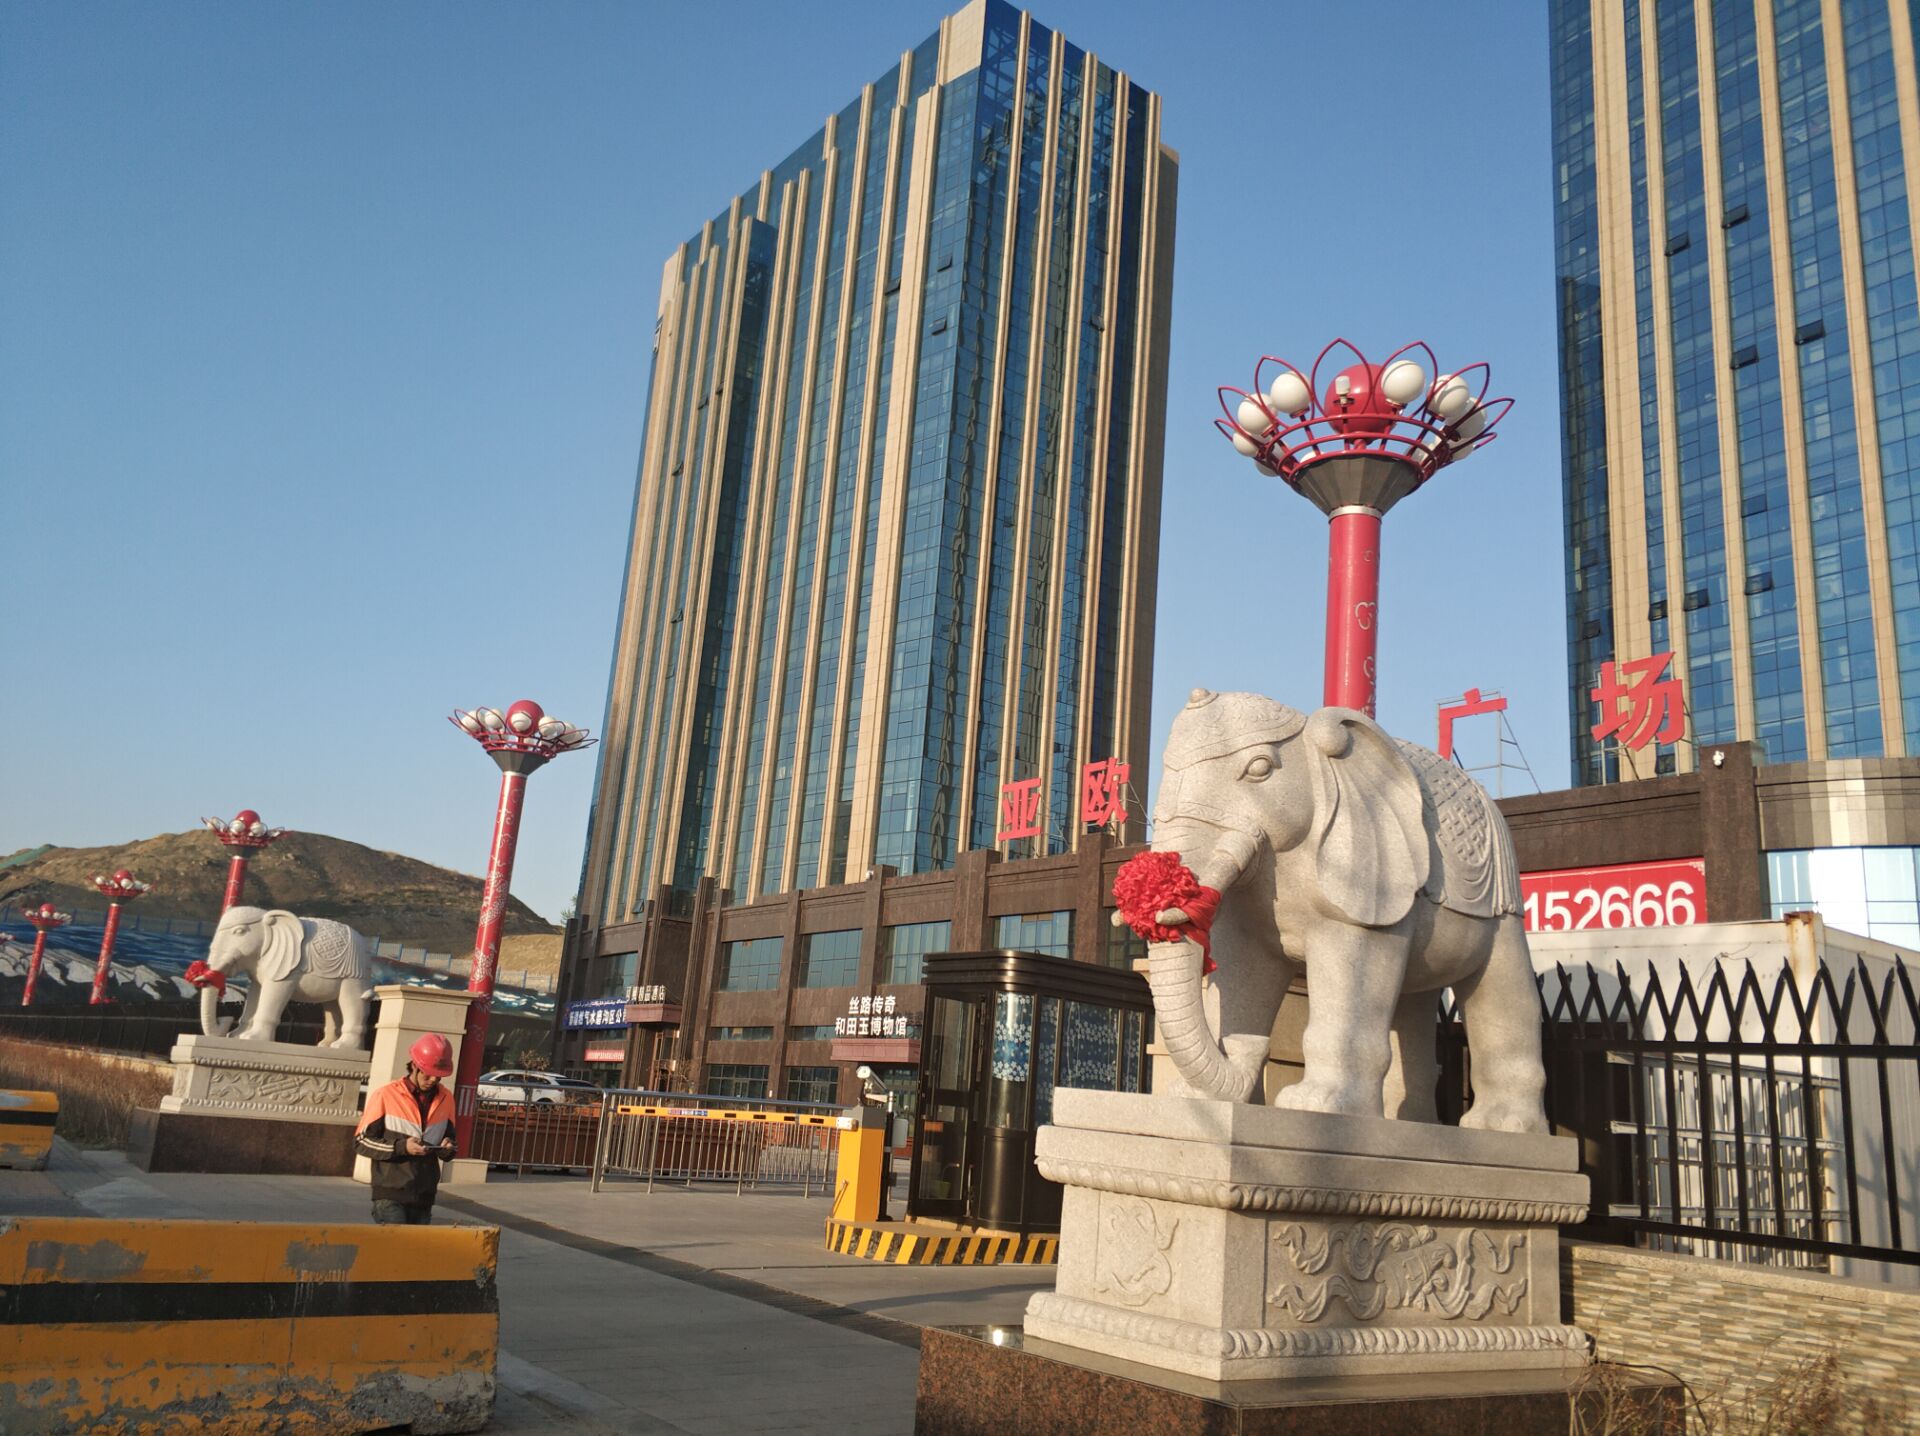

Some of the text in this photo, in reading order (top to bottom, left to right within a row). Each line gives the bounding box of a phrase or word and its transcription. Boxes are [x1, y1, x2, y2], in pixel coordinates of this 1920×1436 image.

[998, 757, 1131, 841] 亚欧
[1524, 881, 1696, 932] 152666
[848, 995, 896, 1015] 丝路传奇
[835, 1016, 907, 1036] 和田玉博物馆
